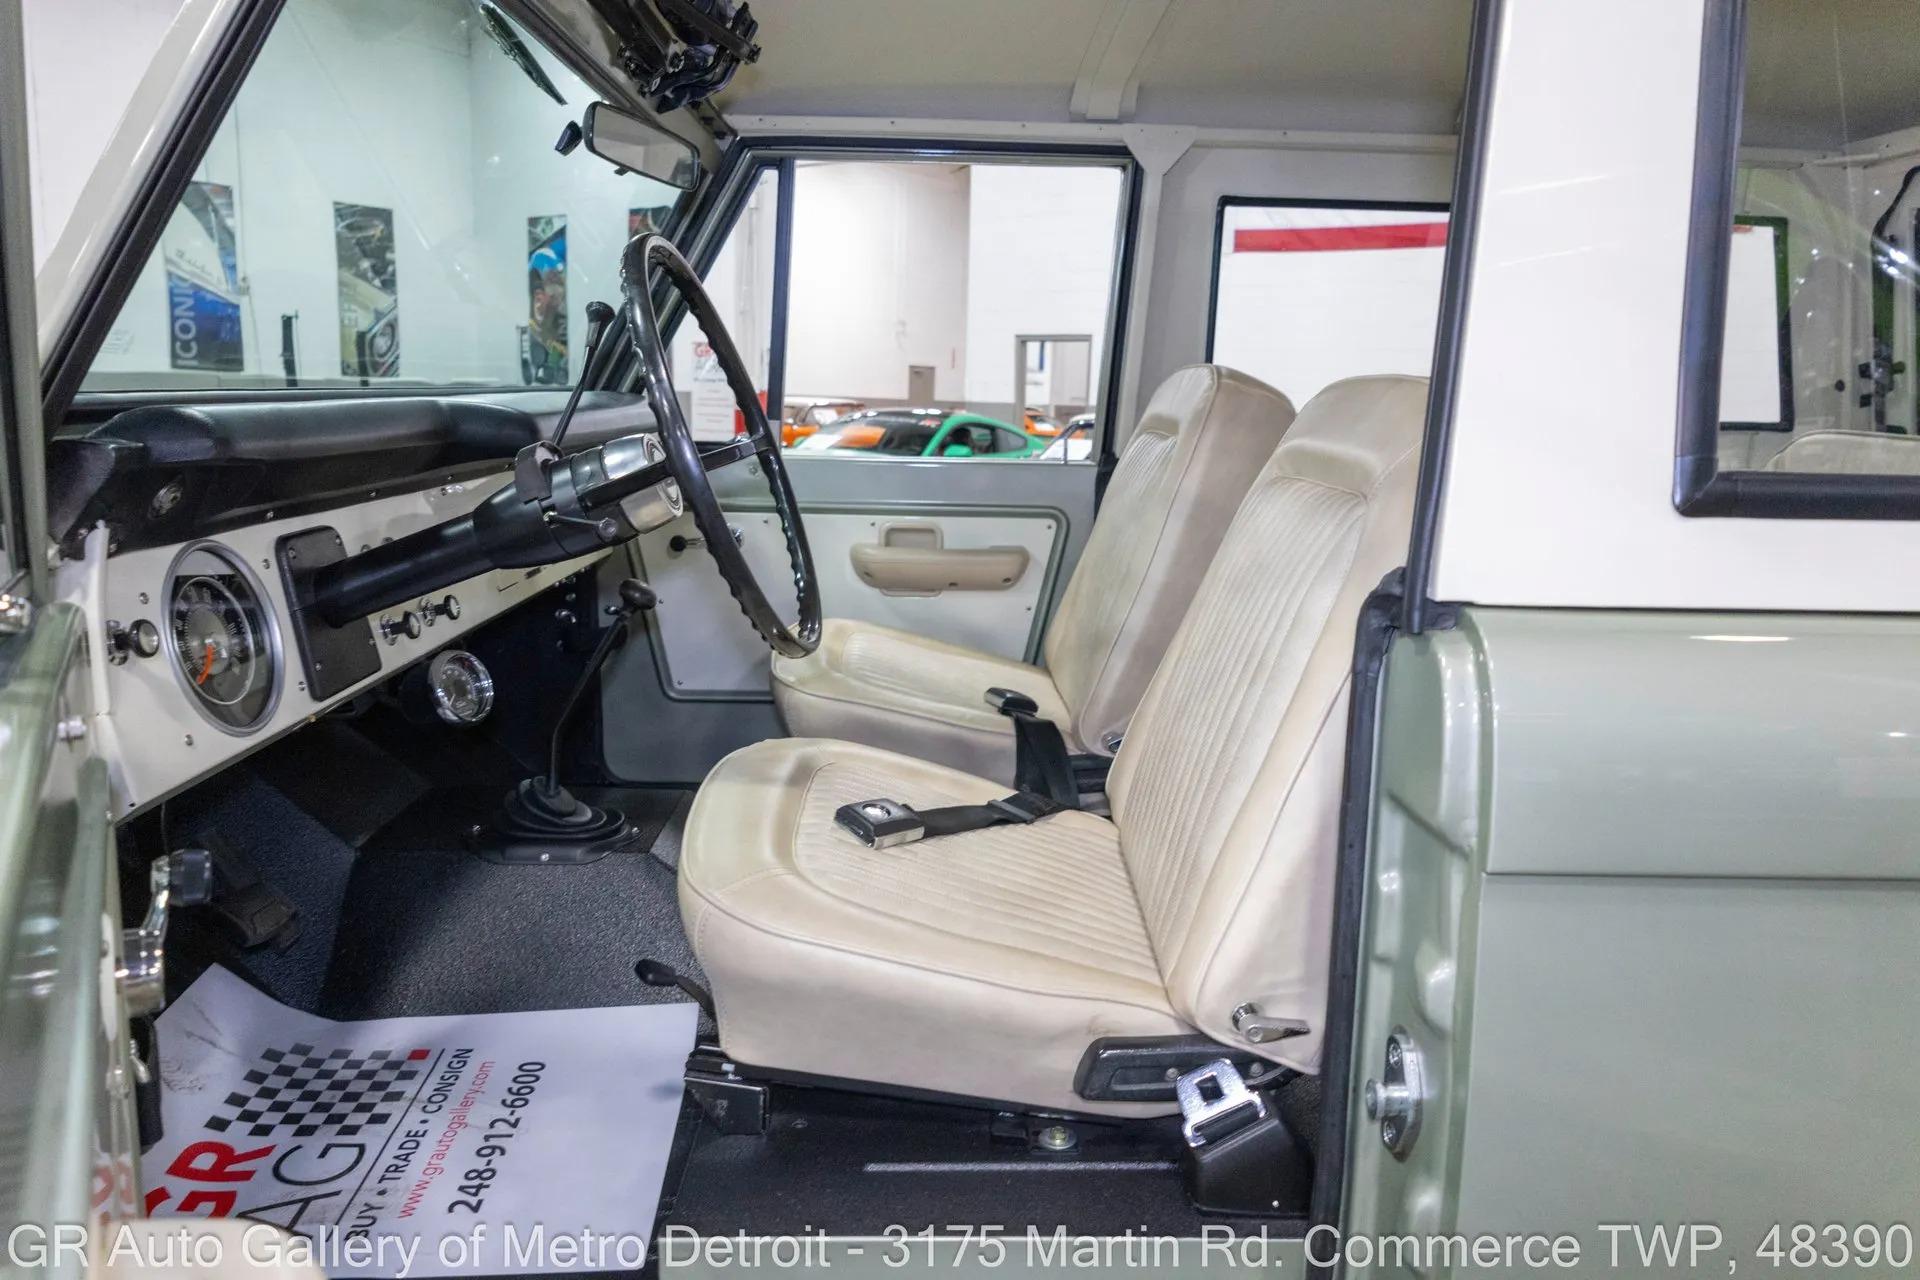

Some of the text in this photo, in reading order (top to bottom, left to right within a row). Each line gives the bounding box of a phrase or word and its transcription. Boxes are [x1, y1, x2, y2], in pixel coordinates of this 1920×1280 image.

[378, 1129, 429, 1184] TRADE
[421, 1048, 474, 1114] CONSIGN
[398, 1060, 495, 1219] www.grautogallery.com
[448, 1061, 546, 1214] 248-912-6600
